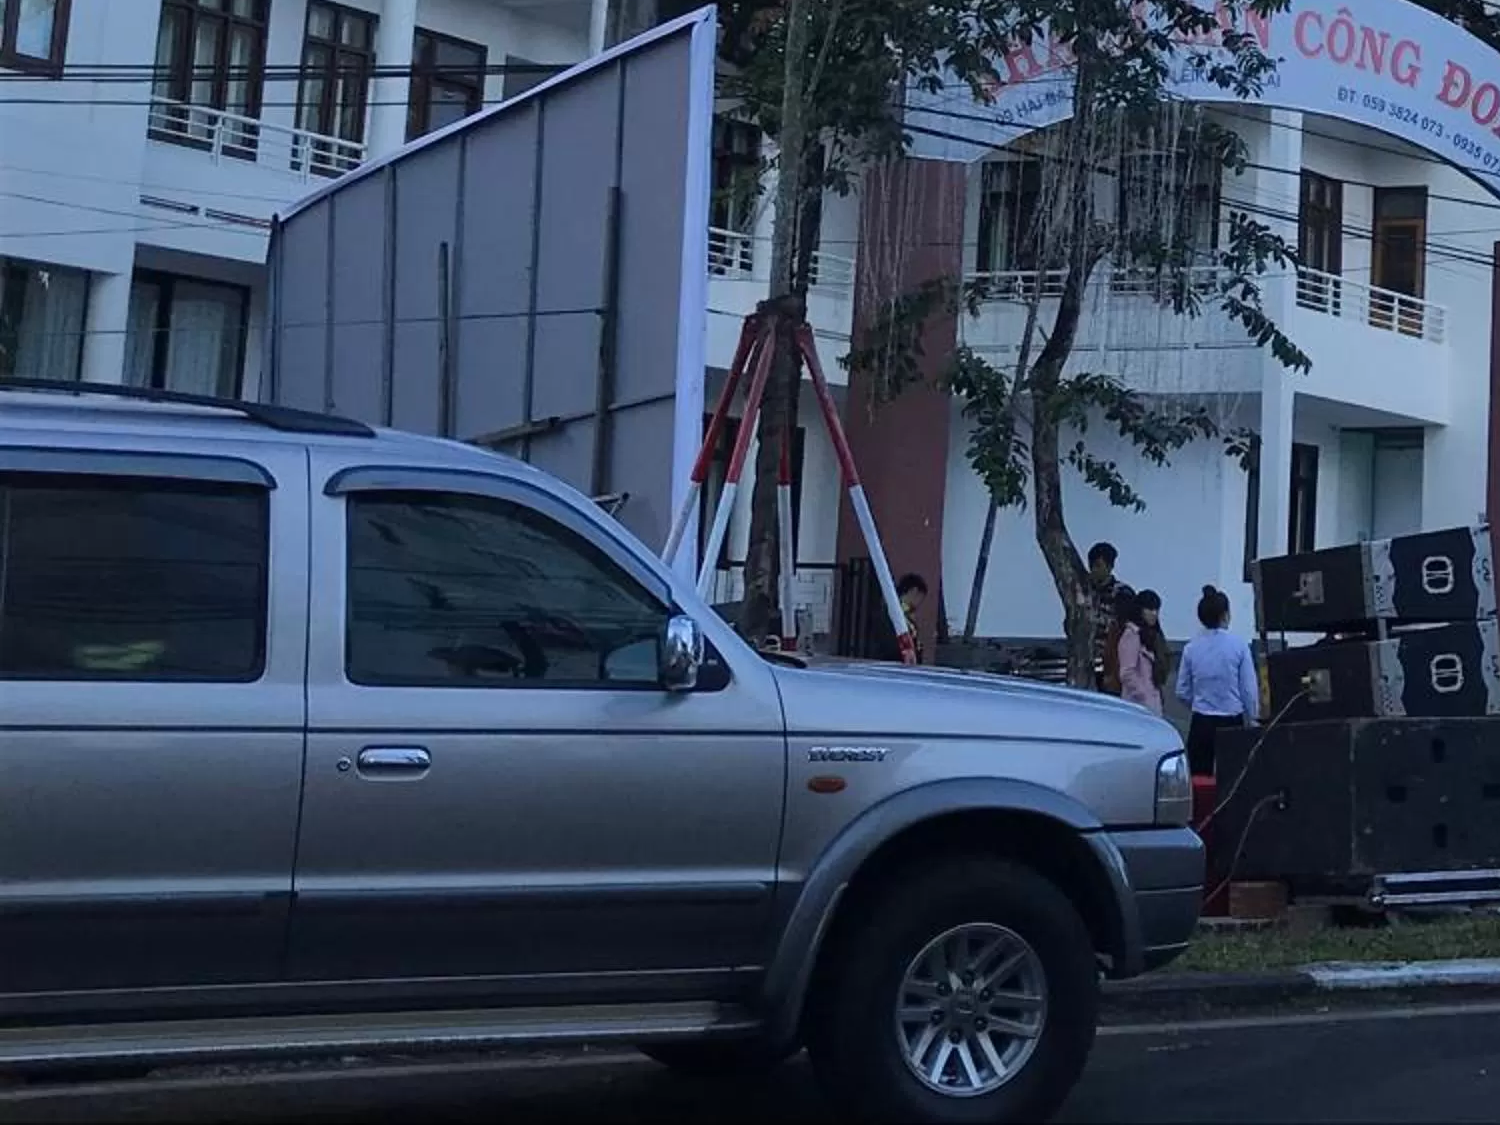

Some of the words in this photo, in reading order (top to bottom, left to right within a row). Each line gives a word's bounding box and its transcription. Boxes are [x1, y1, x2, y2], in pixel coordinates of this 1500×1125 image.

[1294, 6, 1422, 89] CÔNG
[1362, 94, 1386, 112] 059
[1420, 116, 1444, 138] 073
